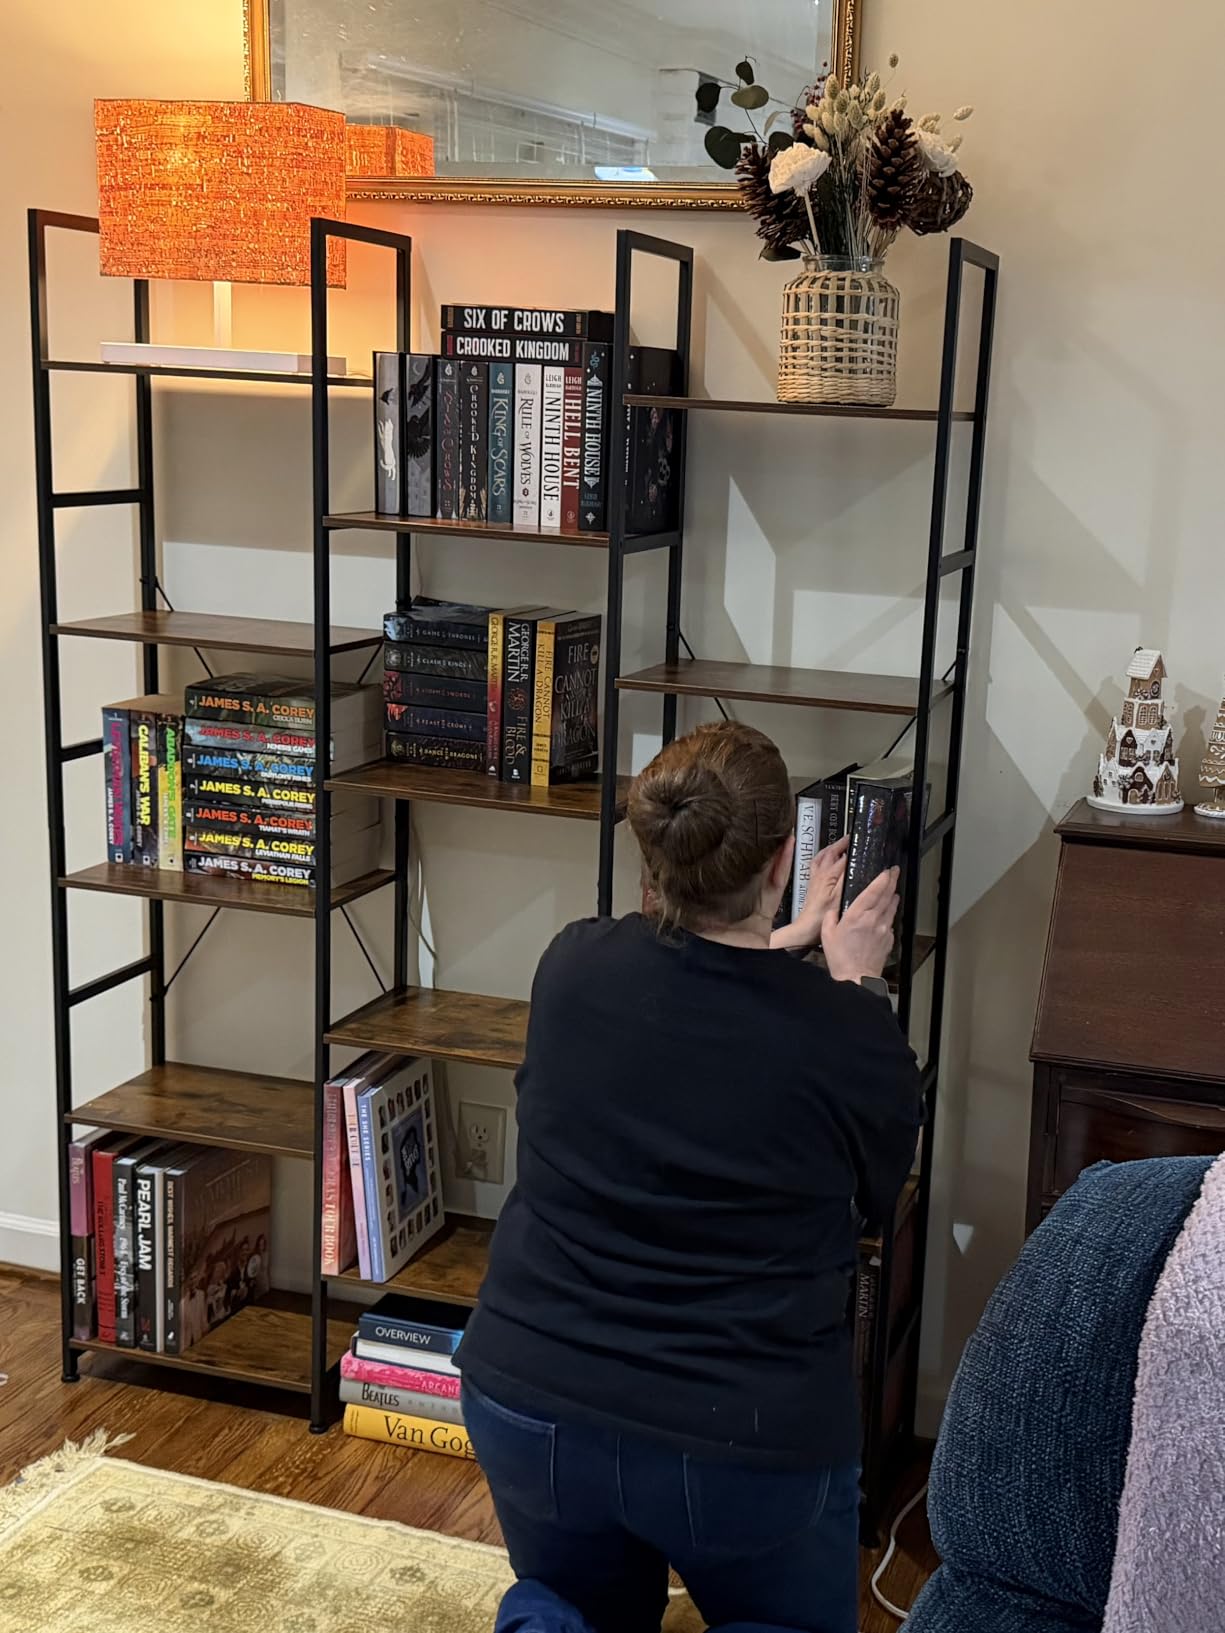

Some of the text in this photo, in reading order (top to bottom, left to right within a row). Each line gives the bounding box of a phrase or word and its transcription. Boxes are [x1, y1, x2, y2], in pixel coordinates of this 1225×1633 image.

[464, 308, 486, 329] SIX
[492, 310, 508, 330] OF
[514, 311, 564, 333] CROWS
[456, 336, 570, 361] CROOKED KINGDOM
[490, 397, 508, 437] KING
[518, 398, 534, 430] RULE
[564, 400, 582, 440] HELL
[586, 388, 602, 430] NINTH
[520, 442, 532, 486] WOLVES
[544, 397, 562, 501] NINTH HOUSE
[563, 447, 580, 490] BENT
[584, 432, 601, 478] HOUSE
[490, 447, 508, 497] SCARS
[508, 622, 520, 682] MARTIN
[521, 623, 530, 662] GEORGE
[568, 642, 589, 664] FIRE
[542, 676, 552, 718] CANNOT
[554, 668, 597, 694] CANNOT
[199, 696, 314, 719] JAMES S. A. COREY
[535, 680, 544, 723] DRAGON
[198, 726, 315, 747] JAMES S. A. COREY
[506, 726, 516, 765] BLOOD
[515, 716, 528, 757] FIRE &
[138, 724, 150, 826] CALIBAN'S WAR
[197, 755, 314, 776] JAMES S. A. COREY
[200, 780, 315, 803] JAMES S. A. COREY
[196, 808, 313, 830] JAMES S. A. COREY
[198, 833, 314, 856] JAMES S. A. COREY
[800, 824, 814, 881] SCHWAB
[198, 856, 312, 879] JAMES S. A. COREY
[118, 1178, 127, 1194] Paul
[137, 1178, 152, 1271] PEARL JAM
[324, 1235, 335, 1265] BOOK
[76, 1258, 86, 1304] GET BACK
[859, 1272, 870, 1318] MARTIN
[376, 1326, 432, 1345] OVERVIEW
[362, 1382, 400, 1407] BEATLES
[384, 1415, 476, 1458] Van Gog
